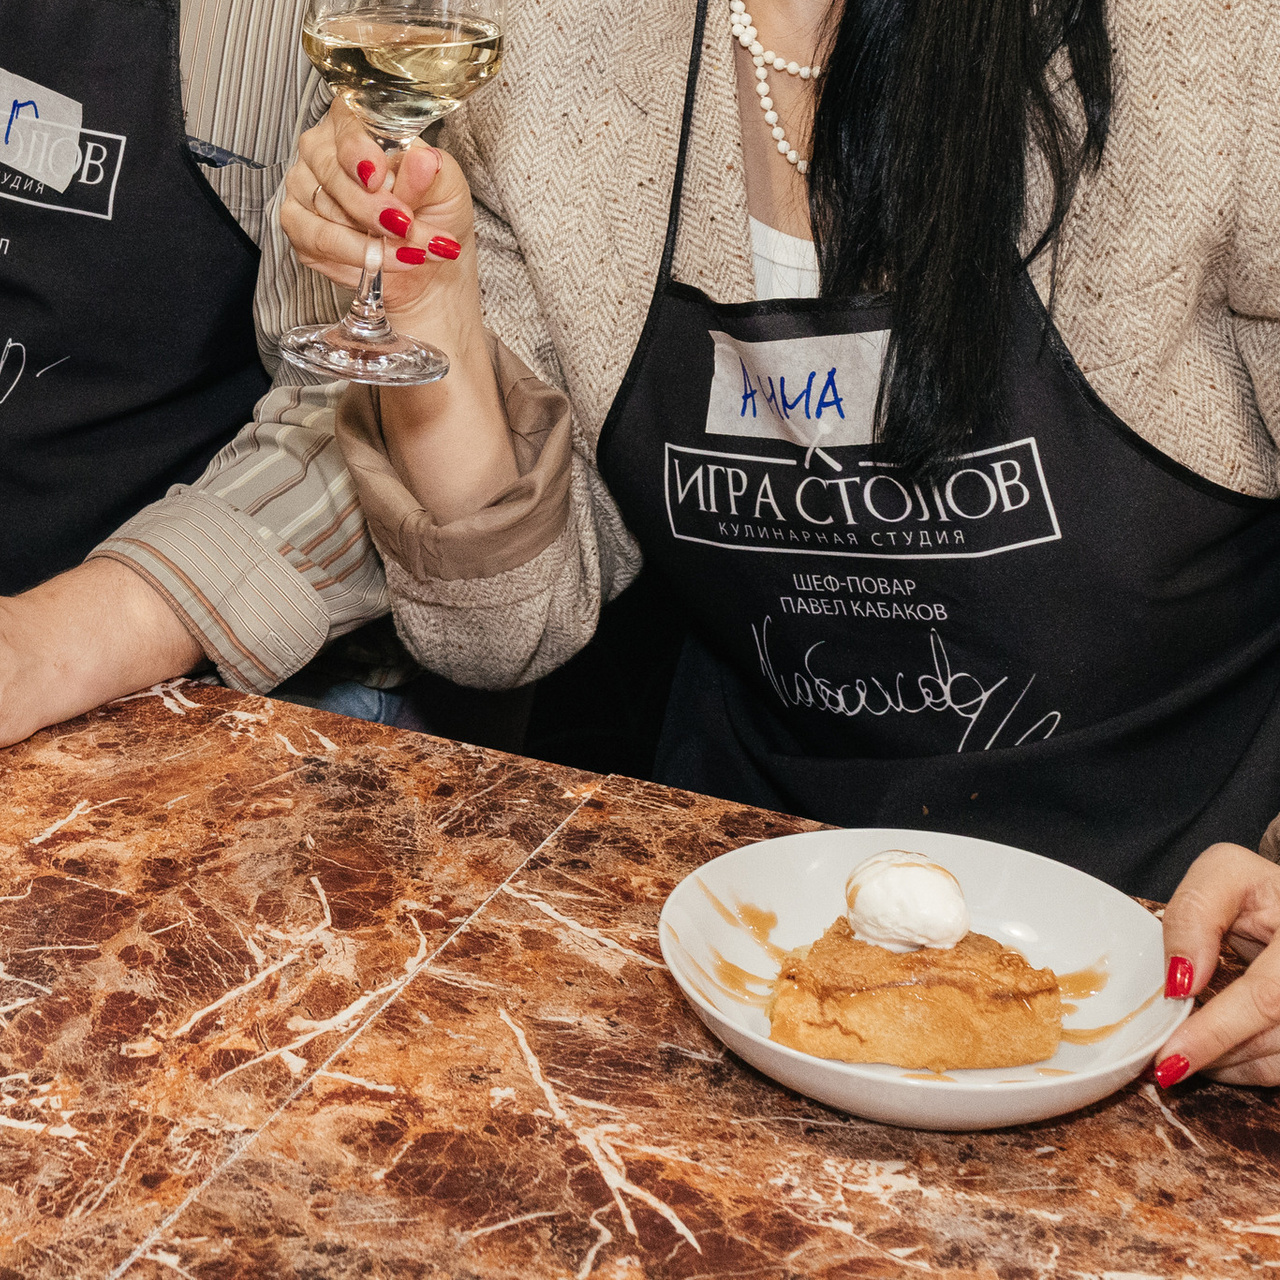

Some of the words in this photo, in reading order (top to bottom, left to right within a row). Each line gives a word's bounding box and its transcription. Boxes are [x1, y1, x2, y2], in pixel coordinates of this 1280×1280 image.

[673, 457, 786, 522] ИГРА
[795, 459, 1031, 526] СТОЛОВ
[718, 521, 859, 547] КУЛИНАРНАЯ
[871, 529, 966, 548] СТУДИЯ
[792, 573, 917, 597] ШЕФ-ПОВАР
[780, 596, 848, 617] ПАВЕЛ
[851, 602, 948, 621] КАБАКОВ
